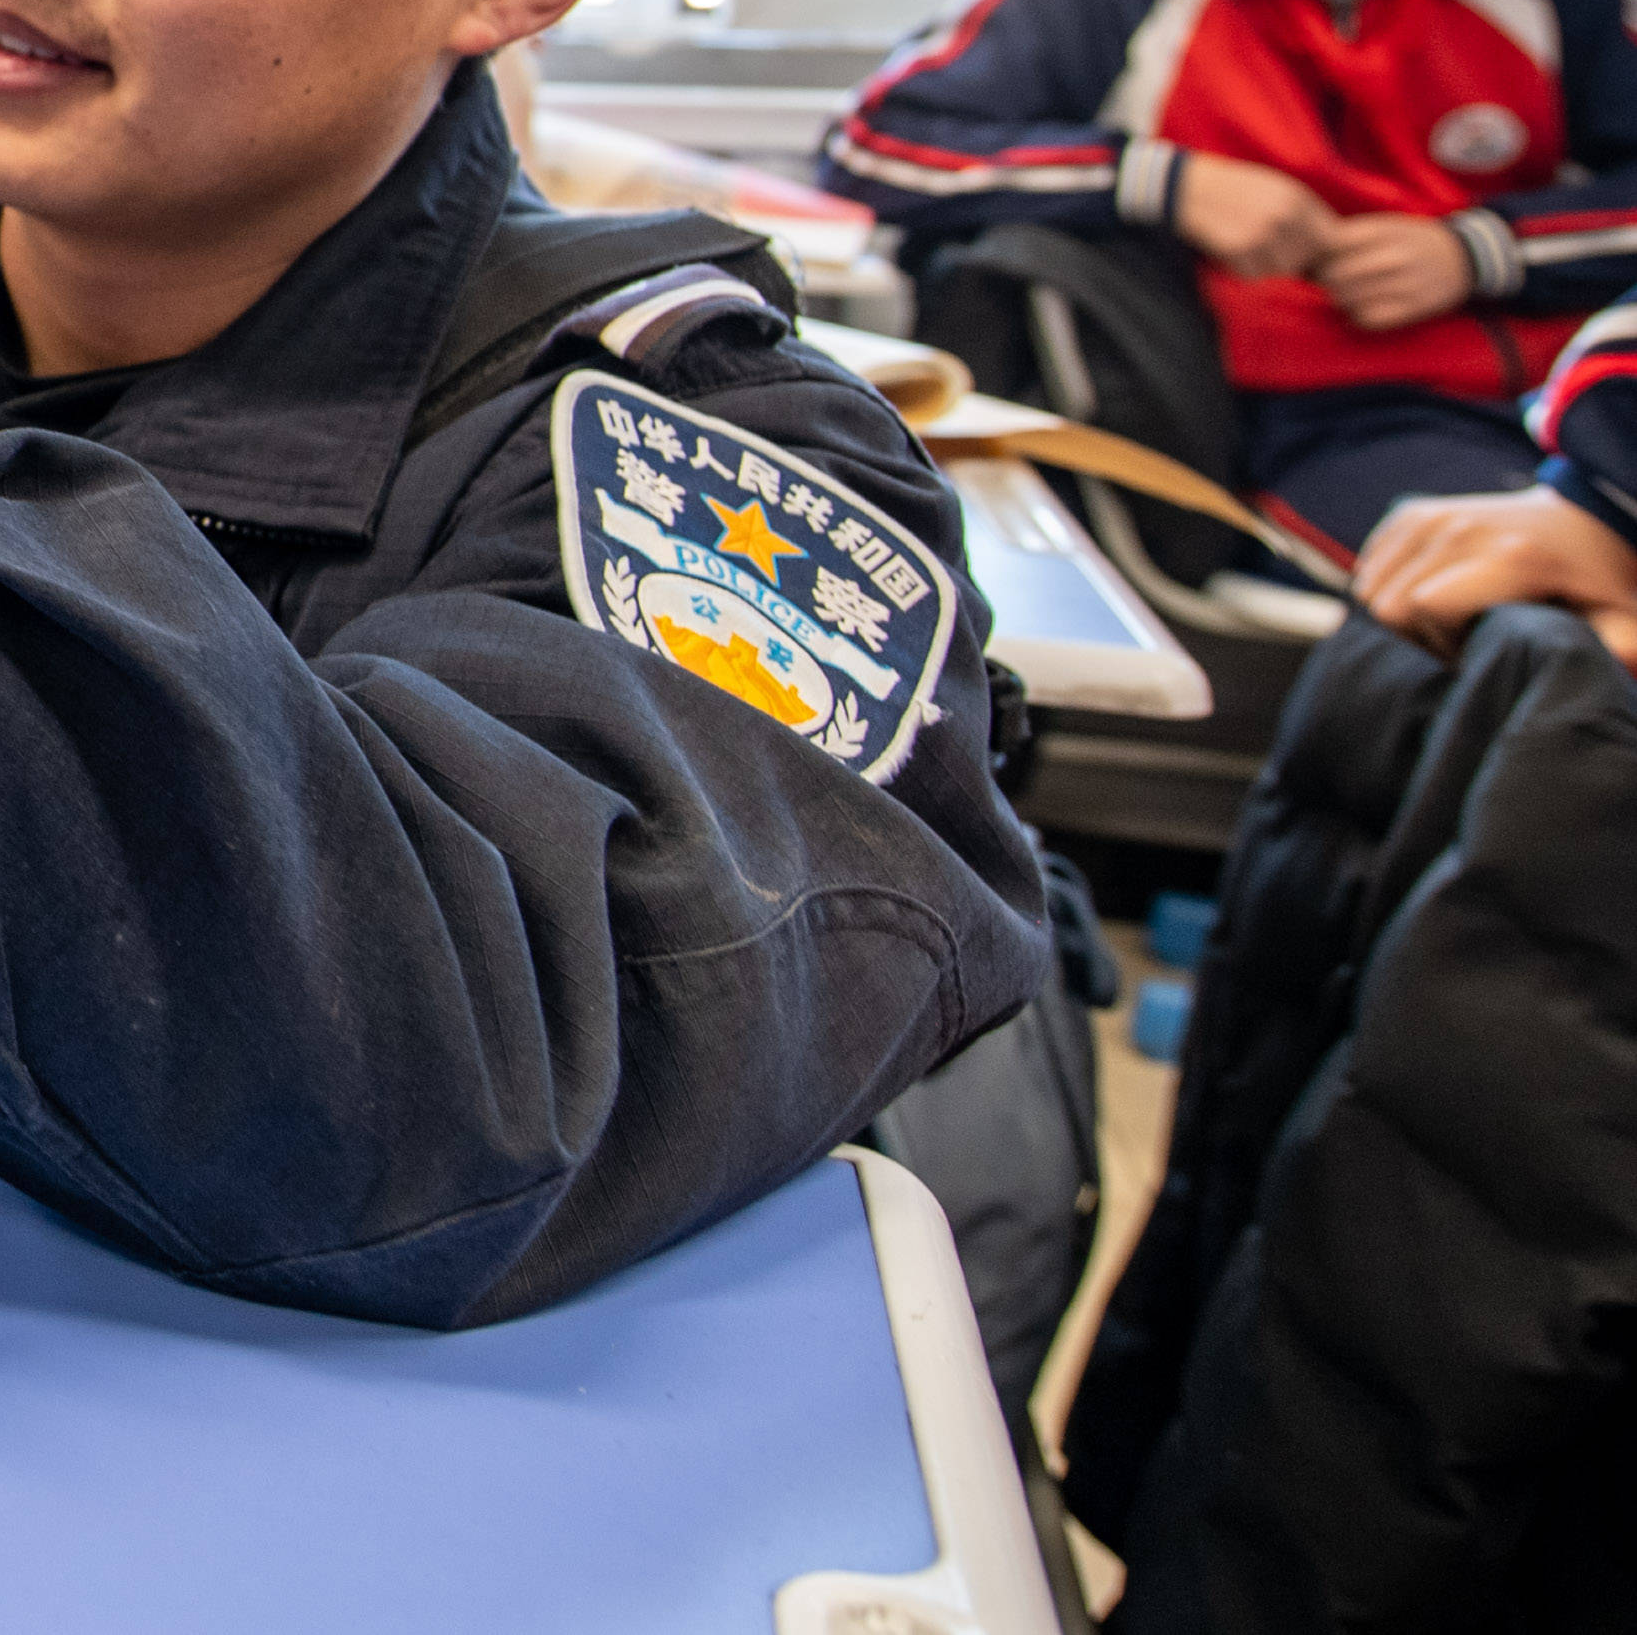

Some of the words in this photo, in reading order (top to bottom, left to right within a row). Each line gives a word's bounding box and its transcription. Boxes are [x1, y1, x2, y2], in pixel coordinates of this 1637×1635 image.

[596, 399, 932, 613] 中华人民共和国
[616, 447, 687, 527] 警
[811, 565, 891, 653] 察
[674, 544, 816, 641] POLICE
